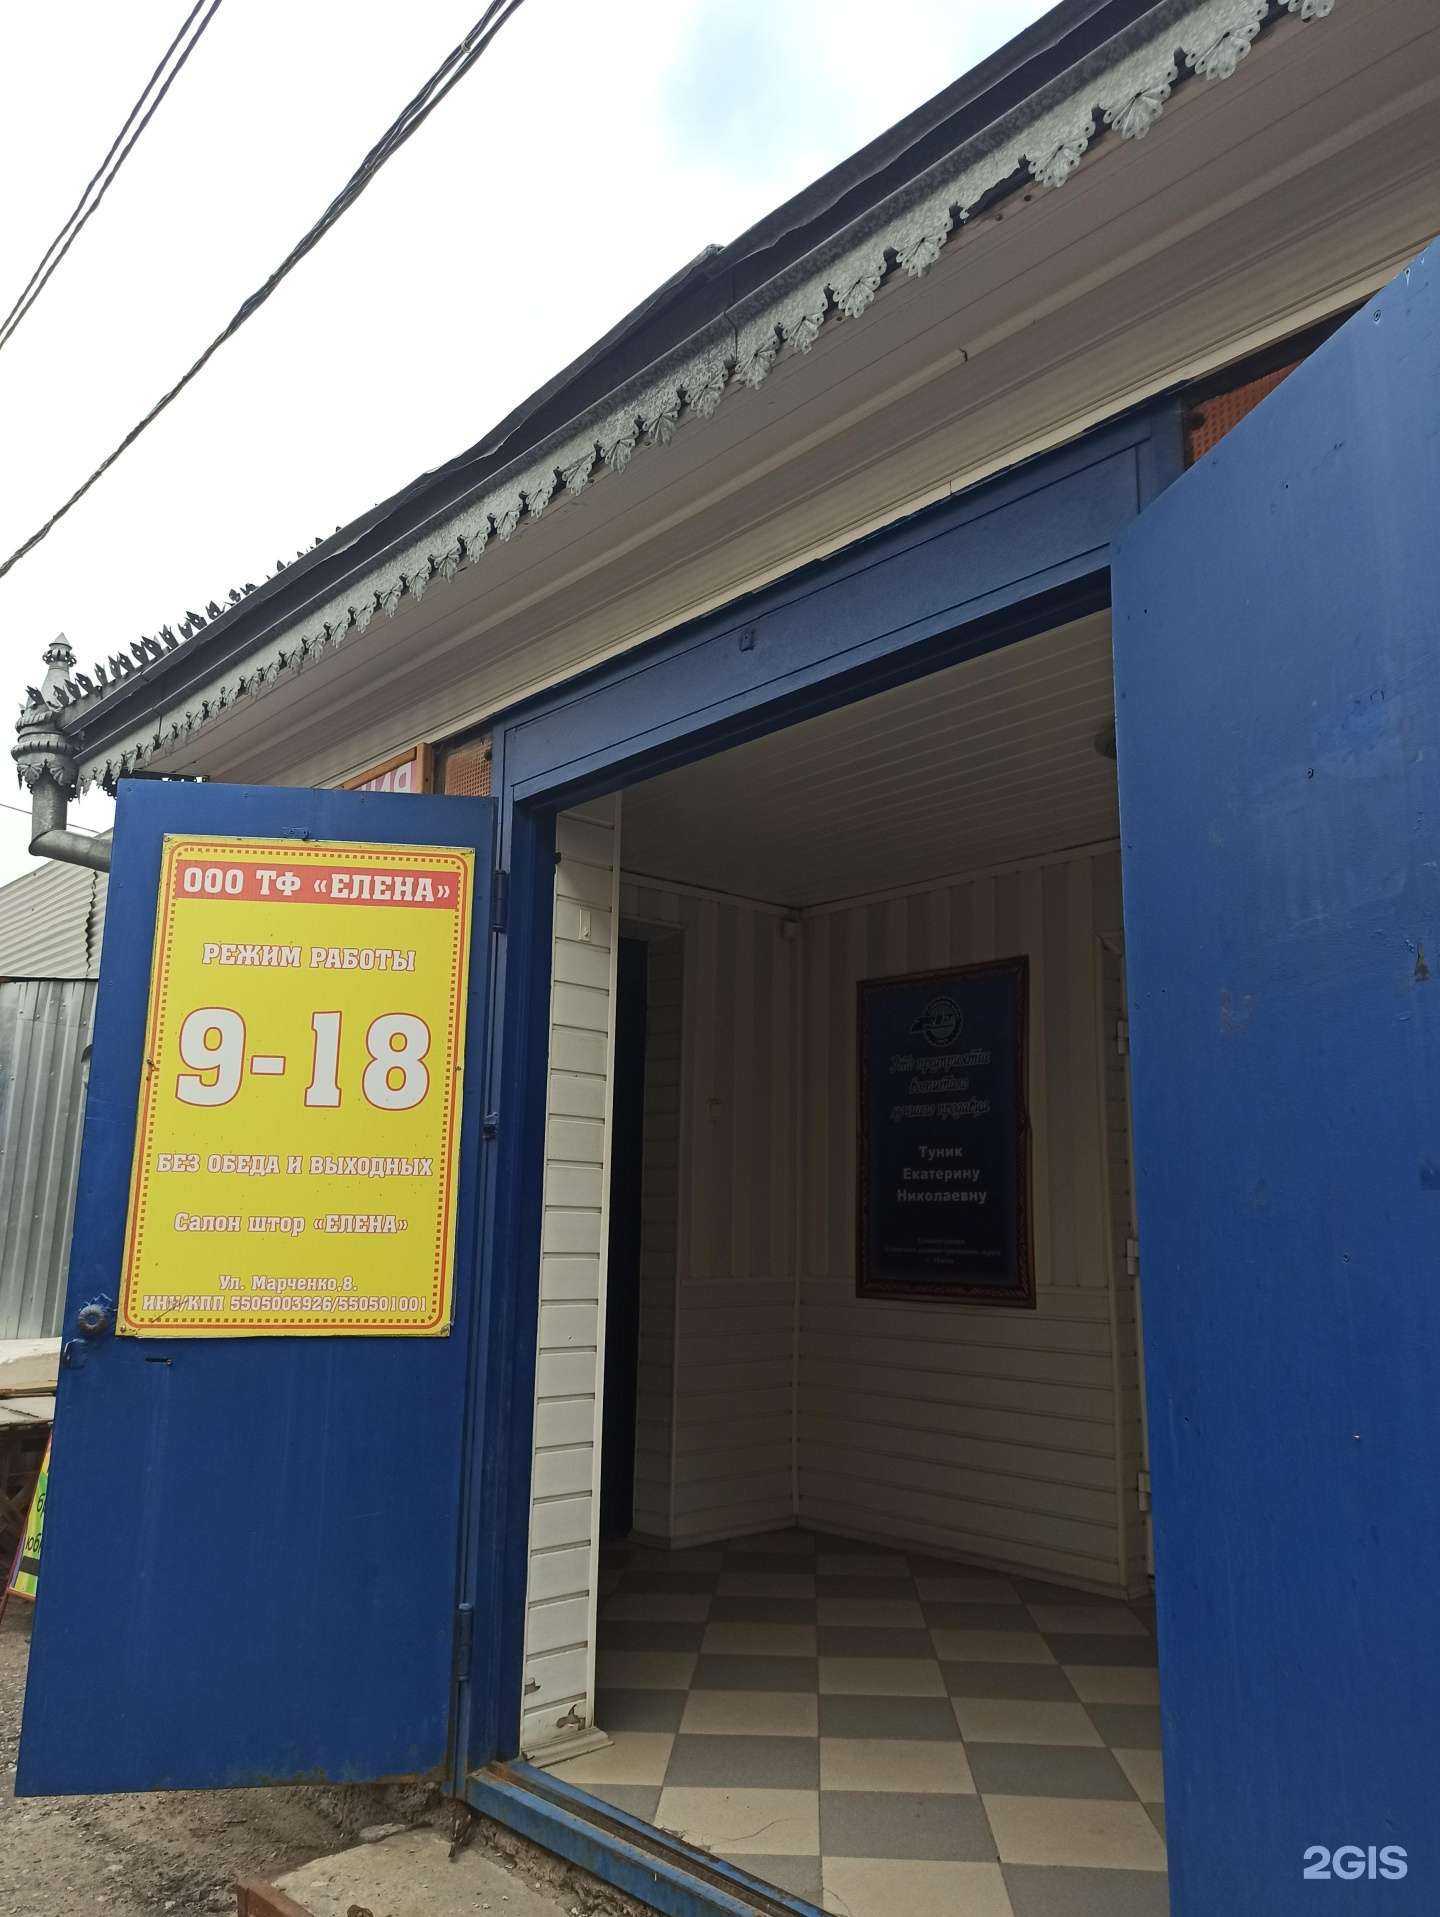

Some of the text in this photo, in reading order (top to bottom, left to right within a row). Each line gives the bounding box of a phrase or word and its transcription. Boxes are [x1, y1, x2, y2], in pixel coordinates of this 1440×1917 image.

[183, 867, 450, 902] ООО ТФ «ЕЛЕНА»
[202, 943, 416, 972] РЕЖИМ РАБОТЫ
[918, 1146, 963, 1160] Туник
[156, 1153, 433, 1178] БЕЗ ОБЕДА И ВЫХОДНЫХ
[902, 1168, 980, 1182] Екатерину
[896, 1188, 987, 1205] Николаевну
[173, 1212, 408, 1236] Салон штор «ЕЛЕНА»
[219, 1275, 245, 1290] Ул.
[142, 1295, 225, 1311] ИНН/КПП
